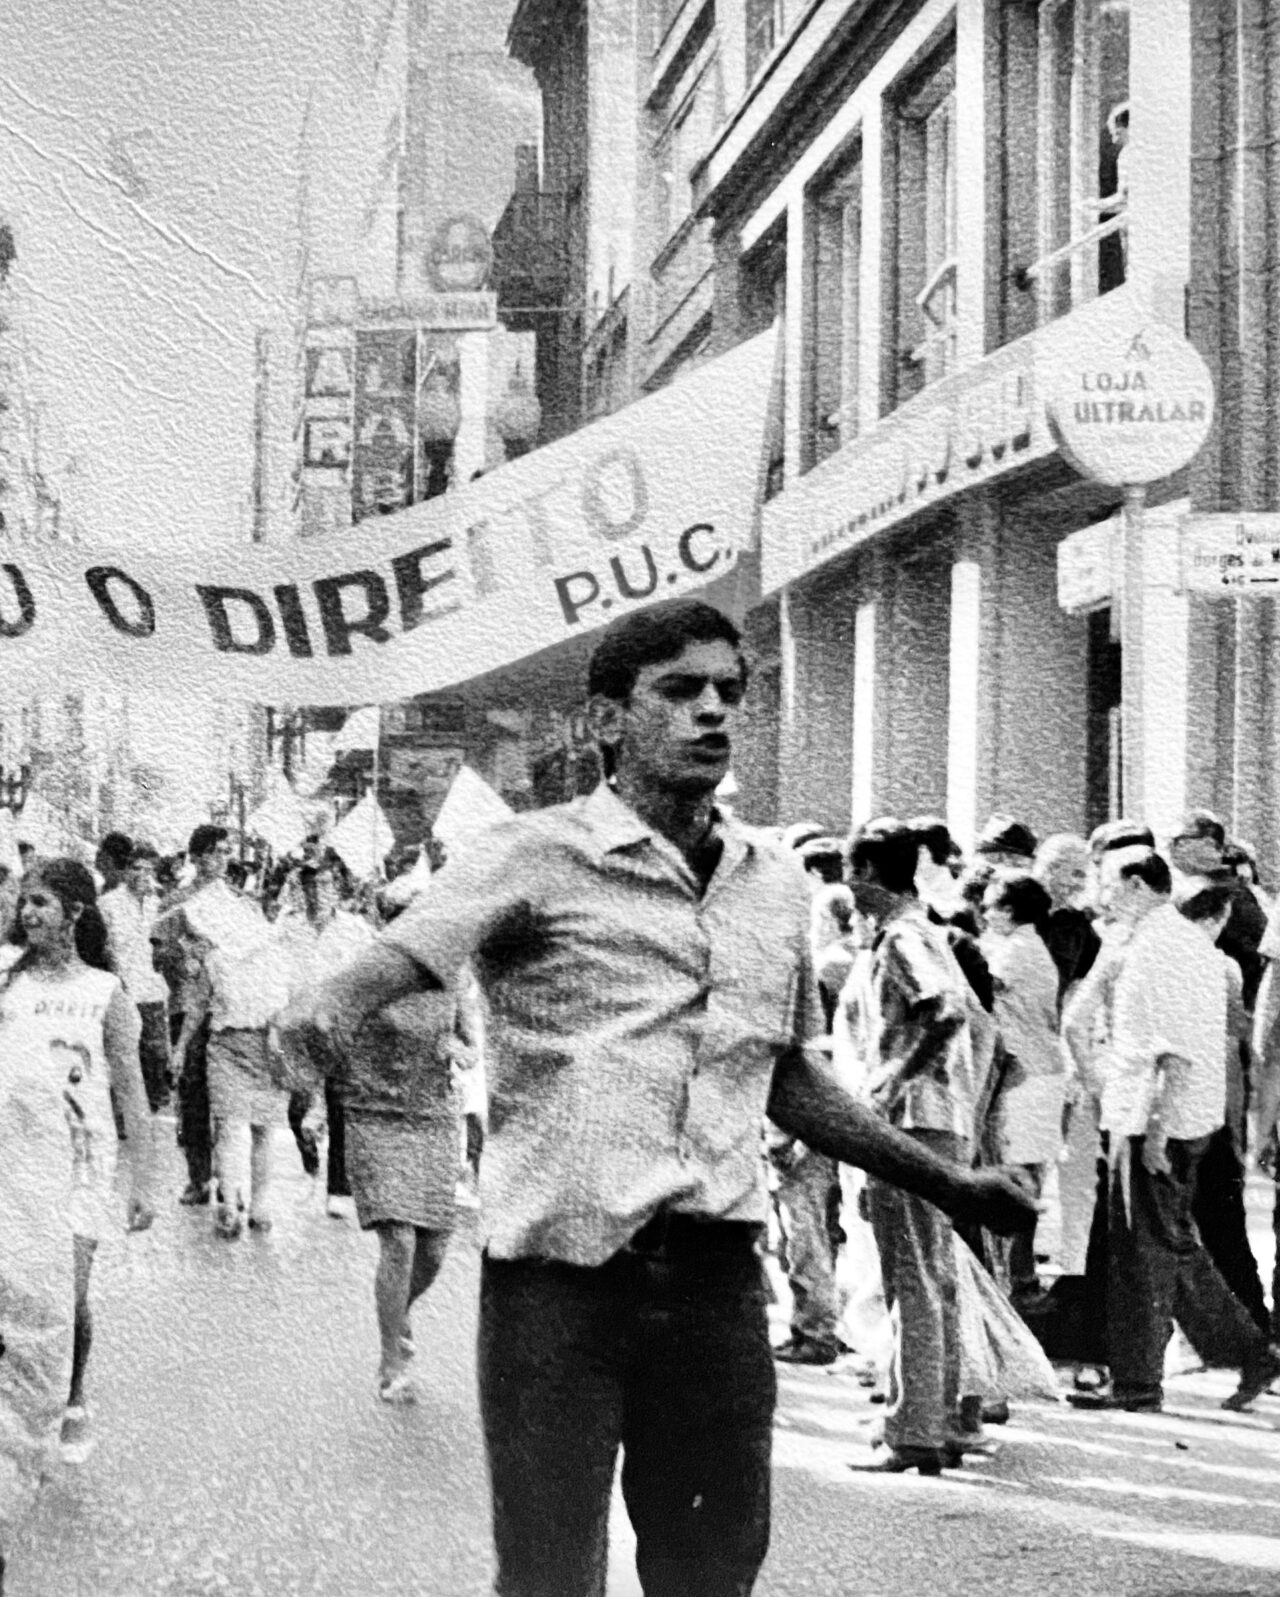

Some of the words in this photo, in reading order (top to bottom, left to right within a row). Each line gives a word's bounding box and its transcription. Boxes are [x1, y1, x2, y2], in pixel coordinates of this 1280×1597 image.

[1074, 401, 1207, 423] ULTRALAR
[1082, 371, 1147, 392] LOJA
[84, 566, 156, 638] O
[194, 448, 648, 660] DIREITO
[554, 523, 732, 625] P.U.C.
